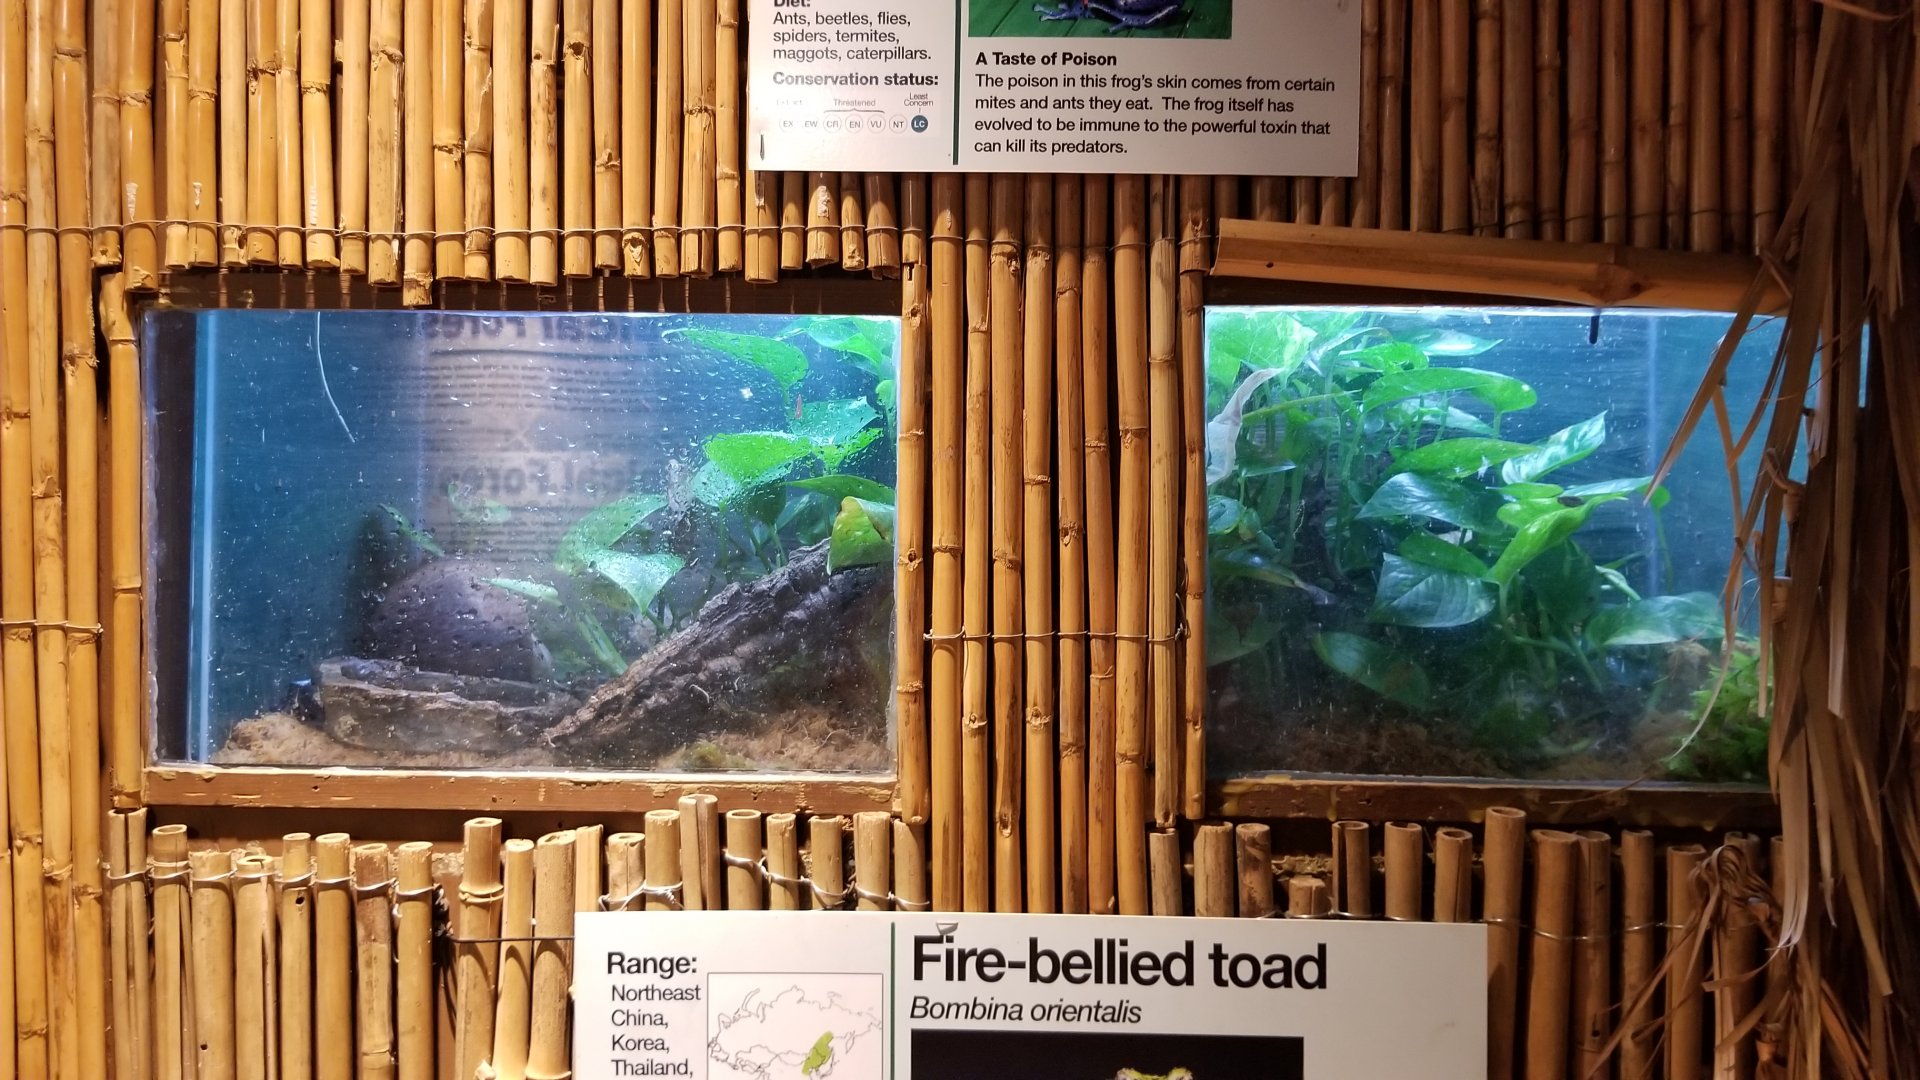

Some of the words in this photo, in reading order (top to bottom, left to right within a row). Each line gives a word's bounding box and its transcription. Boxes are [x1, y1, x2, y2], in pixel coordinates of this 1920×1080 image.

[773, 12, 810, 26] Ants,
[816, 12, 872, 27] beetles,
[878, 12, 910, 27] flies,
[774, 29, 831, 44] spiders,
[836, 29, 899, 44] termites,
[774, 47, 841, 62] maggots,
[847, 46, 931, 62] caterpillars.
[976, 52, 987, 65] A
[992, 52, 1036, 65] Taste
[1041, 52, 1057, 65] of
[1062, 52, 1116, 65] Poison
[773, 72, 878, 85] Conservation
[884, 73, 938, 85] status:
[975, 74, 1003, 87] The
[1008, 74, 1058, 90] poison
[1063, 74, 1075, 87] in
[1080, 74, 1107, 87] this
[1111, 74, 1152, 91] frog's
[1157, 75, 1186, 88] skin
[1191, 79, 1242, 89] comes
[1246, 76, 1280, 90] from
[1285, 78, 1334, 91] certain
[833, 98, 876, 106] Threatened
[910, 92, 928, 100] Least
[976, 96, 1015, 109] mites
[1020, 96, 1048, 109] and
[1053, 97, 1084, 109] ants
[1089, 96, 1121, 113] they
[1126, 98, 1152, 110] eat.
[1162, 97, 1190, 110] The
[1194, 97, 1223, 114] frog
[1229, 98, 1264, 111] itself
[1268, 98, 1294, 112] has
[783, 120, 794, 128] EX
[804, 120, 818, 128] EW
[914, 120, 926, 128] LC
[975, 117, 1032, 130] evolved
[1037, 118, 1052, 130] to
[1057, 118, 1075, 131] be
[1080, 118, 1140, 131] immune
[1144, 119, 1159, 132] to
[1163, 119, 1187, 132] the
[1192, 119, 1256, 135] powerful
[1260, 120, 1296, 134] toxin
[1301, 121, 1330, 134] that
[975, 142, 1001, 152] can
[1006, 139, 1025, 152] kill
[1030, 139, 1047, 152] its
[1052, 140, 1127, 155] predators.
[608, 952, 696, 979] Range:
[914, 935, 1194, 986] Fire-bellied
[1208, 943, 1326, 989] toad
[612, 984, 701, 1001] Northeast
[910, 996, 1023, 1021] Bombina
[1031, 999, 1141, 1023] orientalis
[612, 1009, 668, 1028] China,
[612, 1034, 669, 1053] Korea,
[611, 1059, 692, 1078] Thailand,
